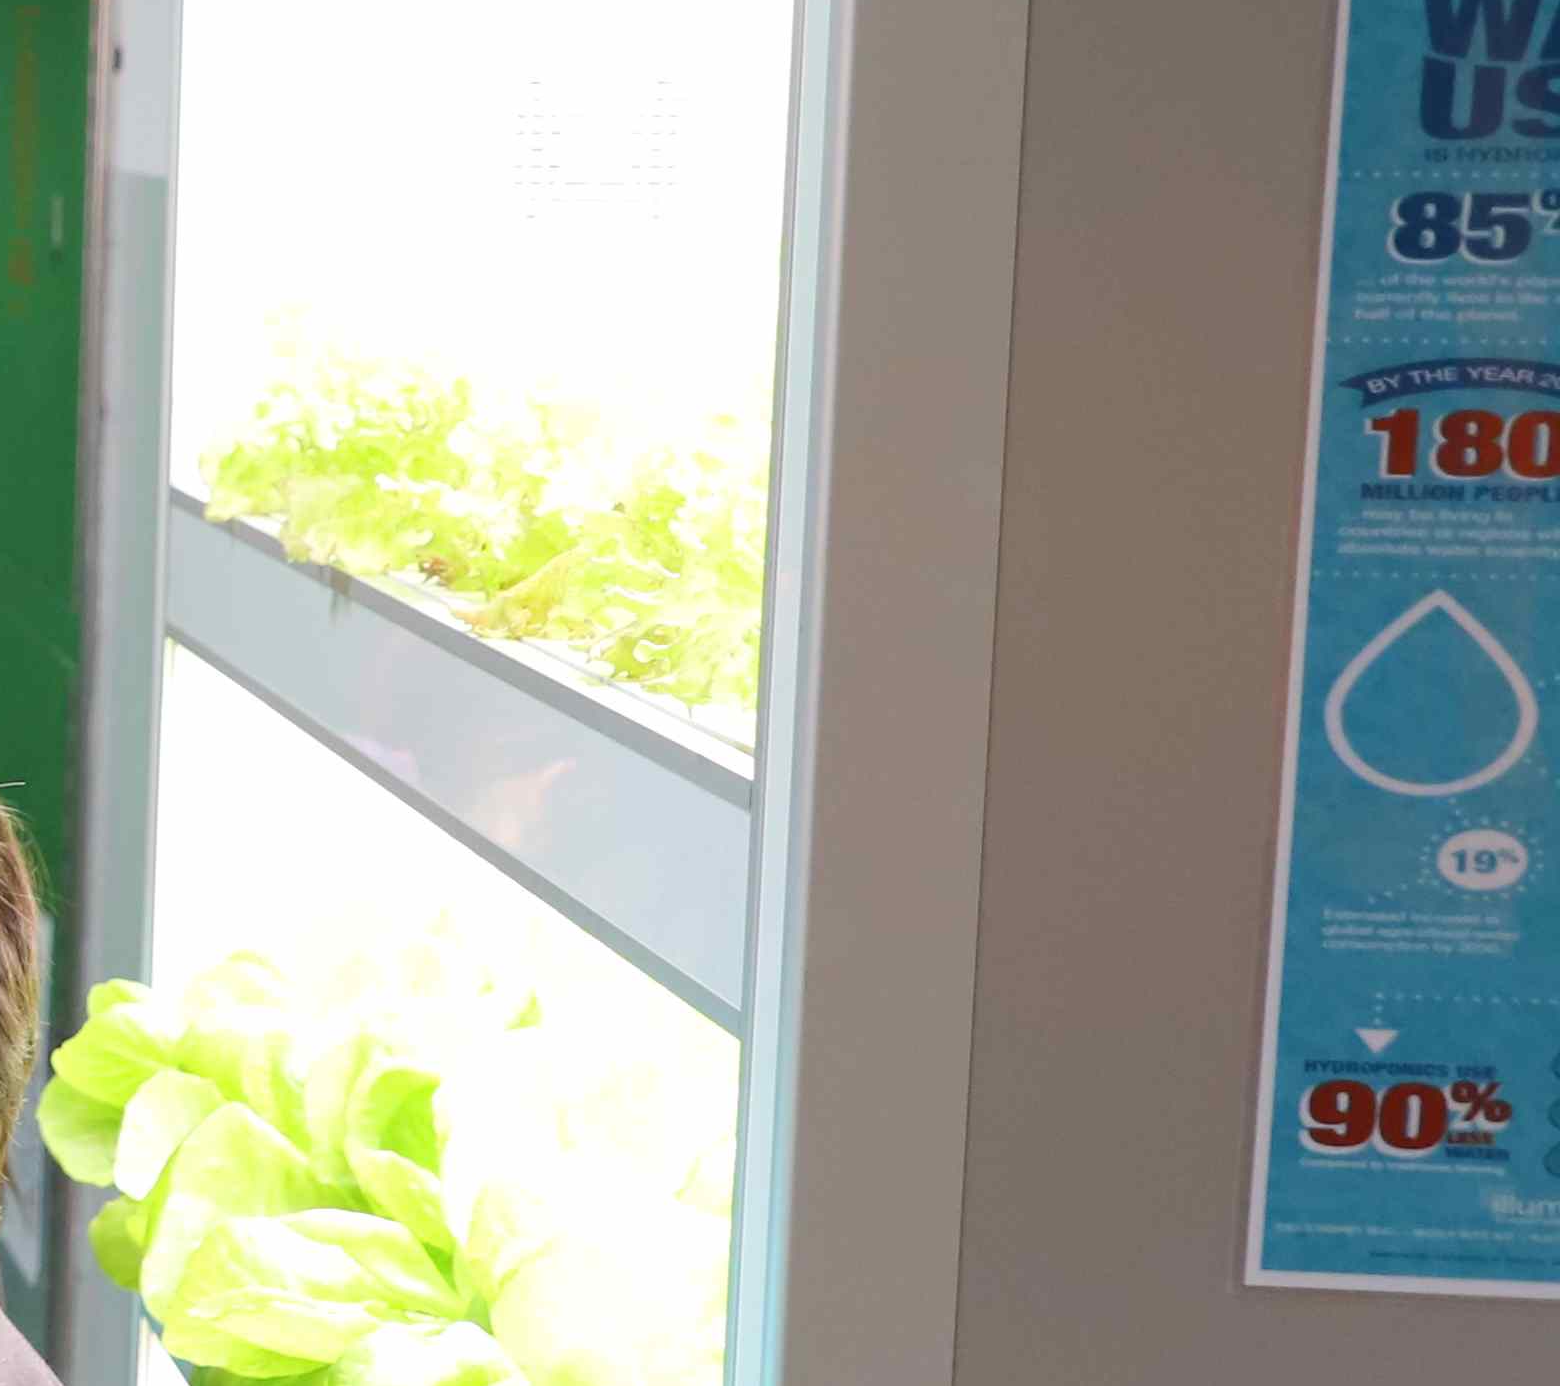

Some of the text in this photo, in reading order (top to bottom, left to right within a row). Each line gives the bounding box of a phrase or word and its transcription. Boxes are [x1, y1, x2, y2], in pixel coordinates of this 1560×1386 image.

[1366, 374, 1402, 394] BY
[1408, 367, 1458, 386] THE
[1466, 366, 1536, 385] YEAR
[1360, 483, 1466, 501] MILLION
[1450, 847, 1521, 874] 19%
[1298, 1079, 1514, 1158] 90%
